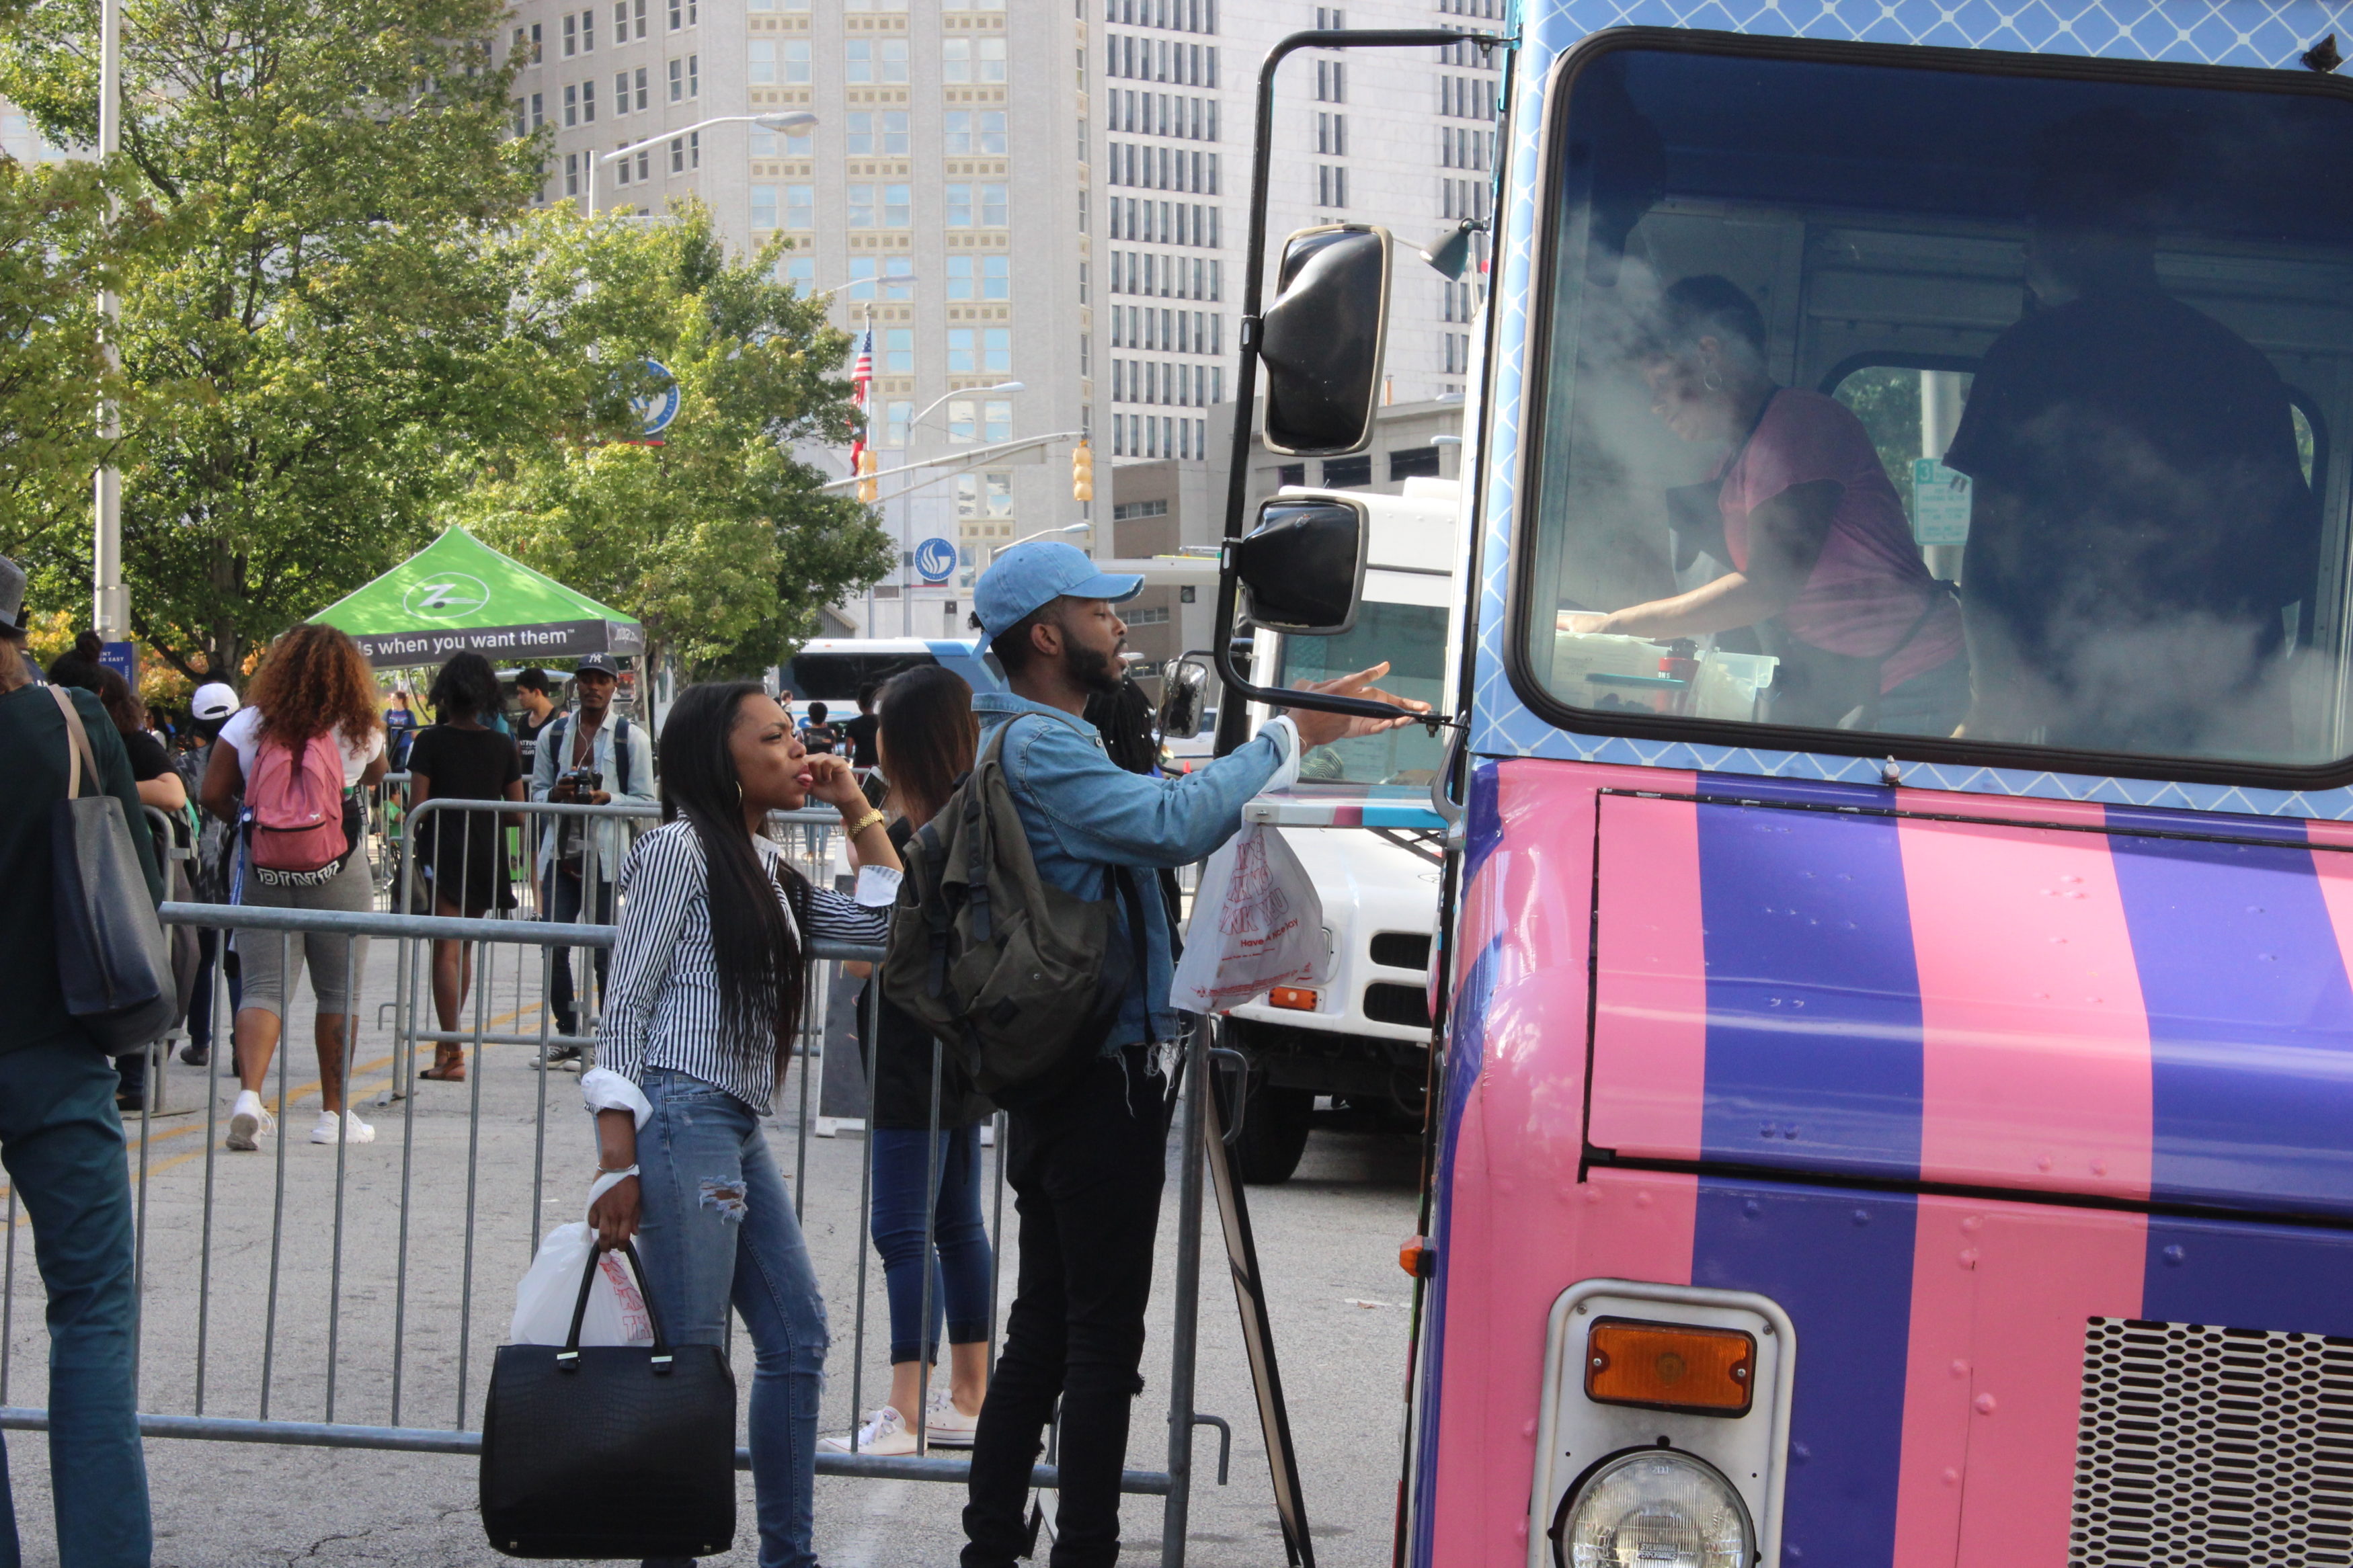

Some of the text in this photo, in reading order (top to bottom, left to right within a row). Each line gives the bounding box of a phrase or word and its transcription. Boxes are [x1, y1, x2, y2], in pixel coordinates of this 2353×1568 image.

[1919, 463, 1930, 481] 3
[378, 638, 428, 655] when
[433, 636, 465, 655] you
[471, 632, 516, 648] want
[1241, 938, 1265, 948] Have
[1640, 1543, 1676, 1552] SYLVANIA
[1638, 1550, 1677, 1560] PERFORMANCE
